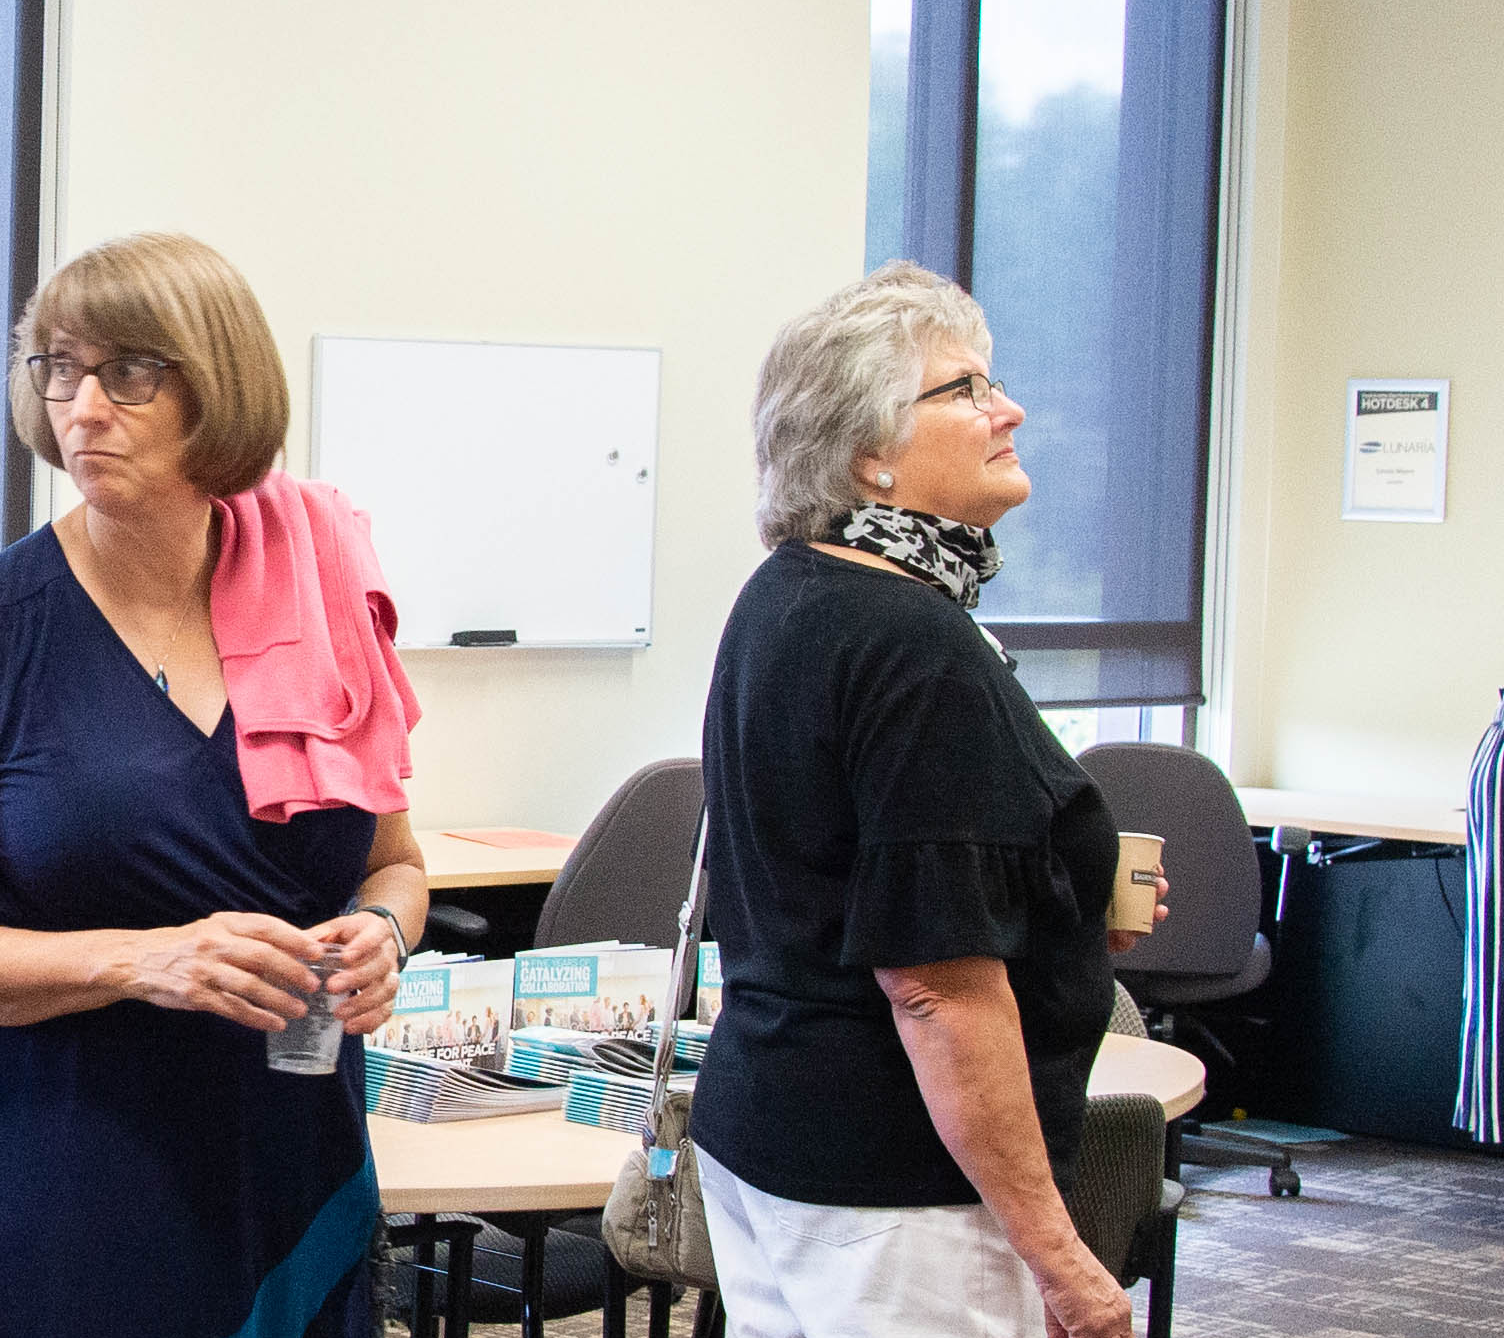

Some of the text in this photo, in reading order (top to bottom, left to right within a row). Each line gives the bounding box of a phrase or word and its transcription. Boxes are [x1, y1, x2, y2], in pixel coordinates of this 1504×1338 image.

[1361, 396, 1429, 410] HOTDESK 4
[521, 965, 590, 983] CATALYZING
[519, 981, 590, 994] COLLABORATION
[436, 1045, 459, 1060] FOR
[460, 1043, 496, 1058] PEACE
